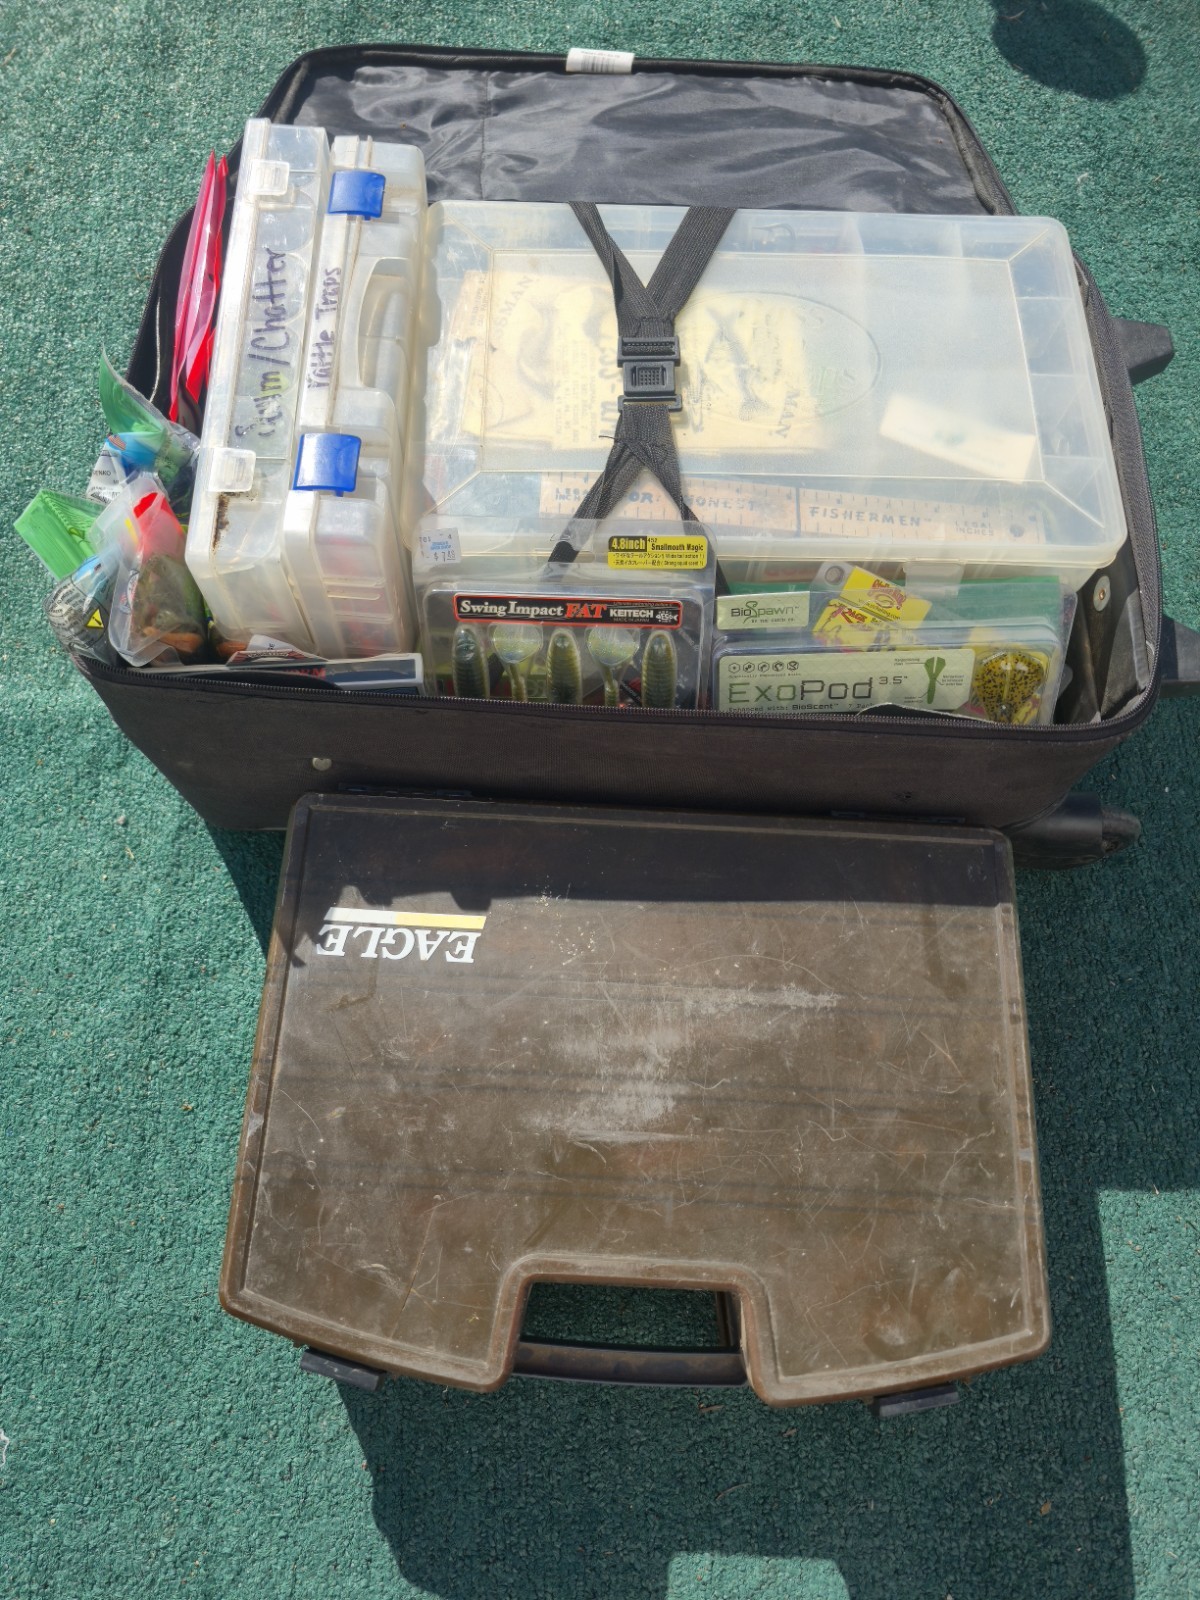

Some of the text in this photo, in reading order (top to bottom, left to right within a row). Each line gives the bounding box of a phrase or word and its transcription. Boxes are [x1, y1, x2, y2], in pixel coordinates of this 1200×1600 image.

[611, 537, 646, 550] 4.8inch
[651, 543, 704, 552] Smallmouth Magic
[460, 599, 608, 619] Swing Impact FAT
[609, 608, 654, 619] KEITECH
[728, 676, 873, 704] ExoPod
[316, 924, 482, 964] EAGLE
